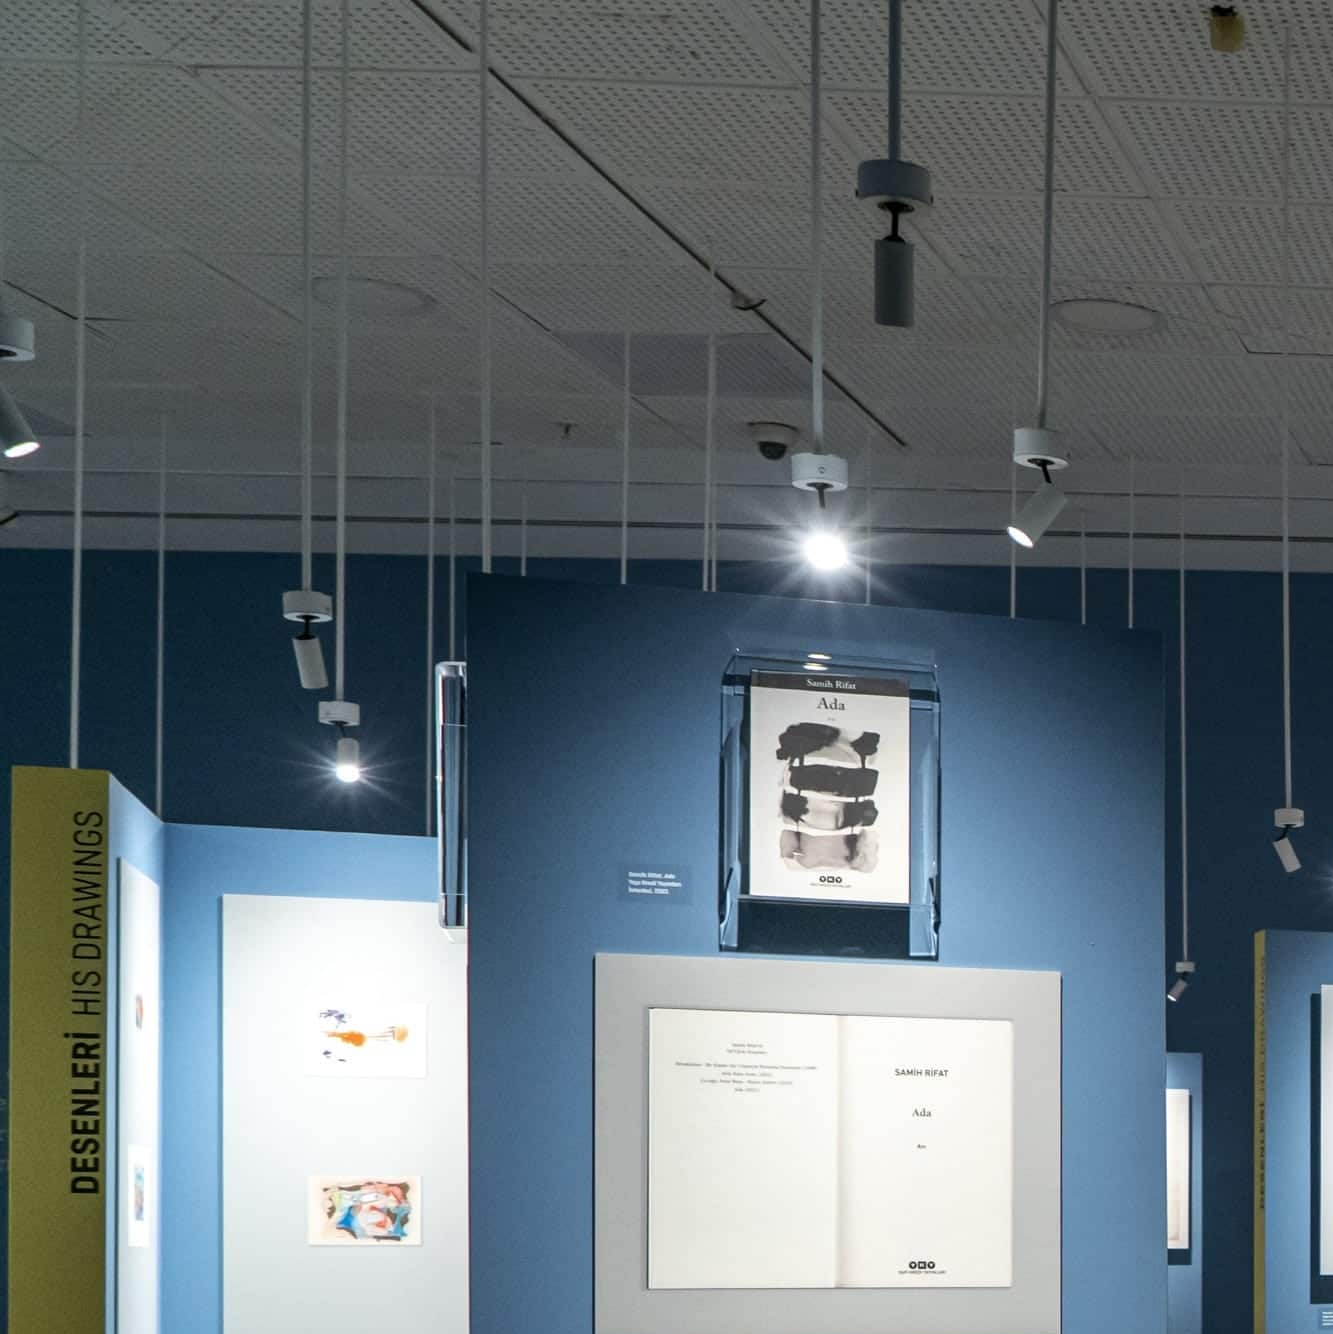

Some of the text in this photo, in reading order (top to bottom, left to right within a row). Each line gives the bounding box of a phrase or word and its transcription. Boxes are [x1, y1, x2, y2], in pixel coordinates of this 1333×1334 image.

[806, 678, 857, 690] Samih Rifat
[816, 697, 846, 711] Ada
[64, 811, 104, 1194] DESENLERİ HIS DRAWINGS
[894, 1067, 949, 1078] SAMİH RİFAT
[911, 1107, 932, 1118] Ada
